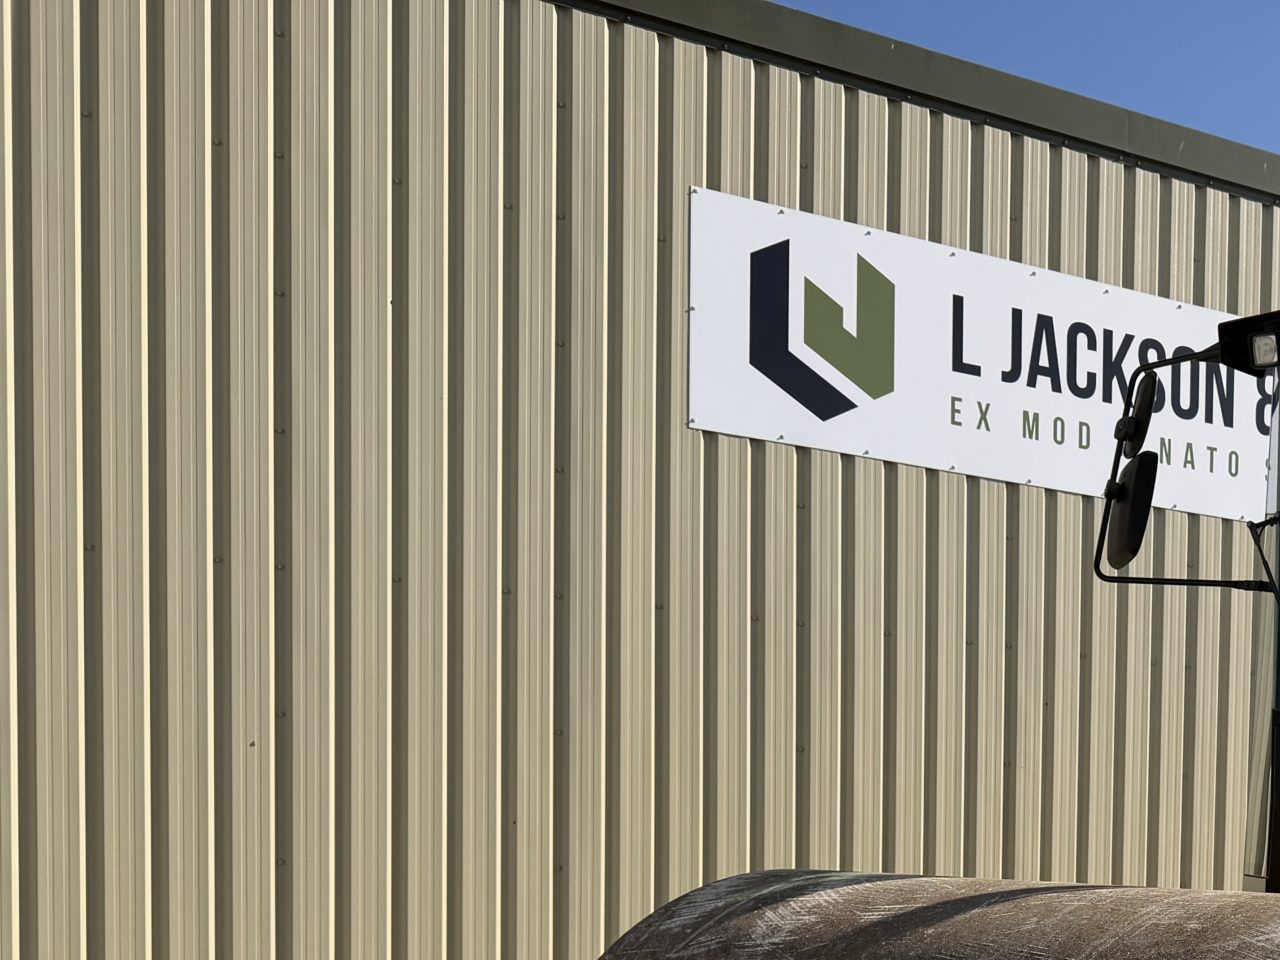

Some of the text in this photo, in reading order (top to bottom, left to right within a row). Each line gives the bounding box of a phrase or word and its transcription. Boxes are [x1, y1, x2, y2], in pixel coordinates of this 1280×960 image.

[951, 293, 982, 378] L
[1001, 306, 1235, 429] JACKSON
[950, 395, 991, 432] EX
[1022, 409, 1091, 450] MOD
[1159, 436, 1239, 478] NATO
